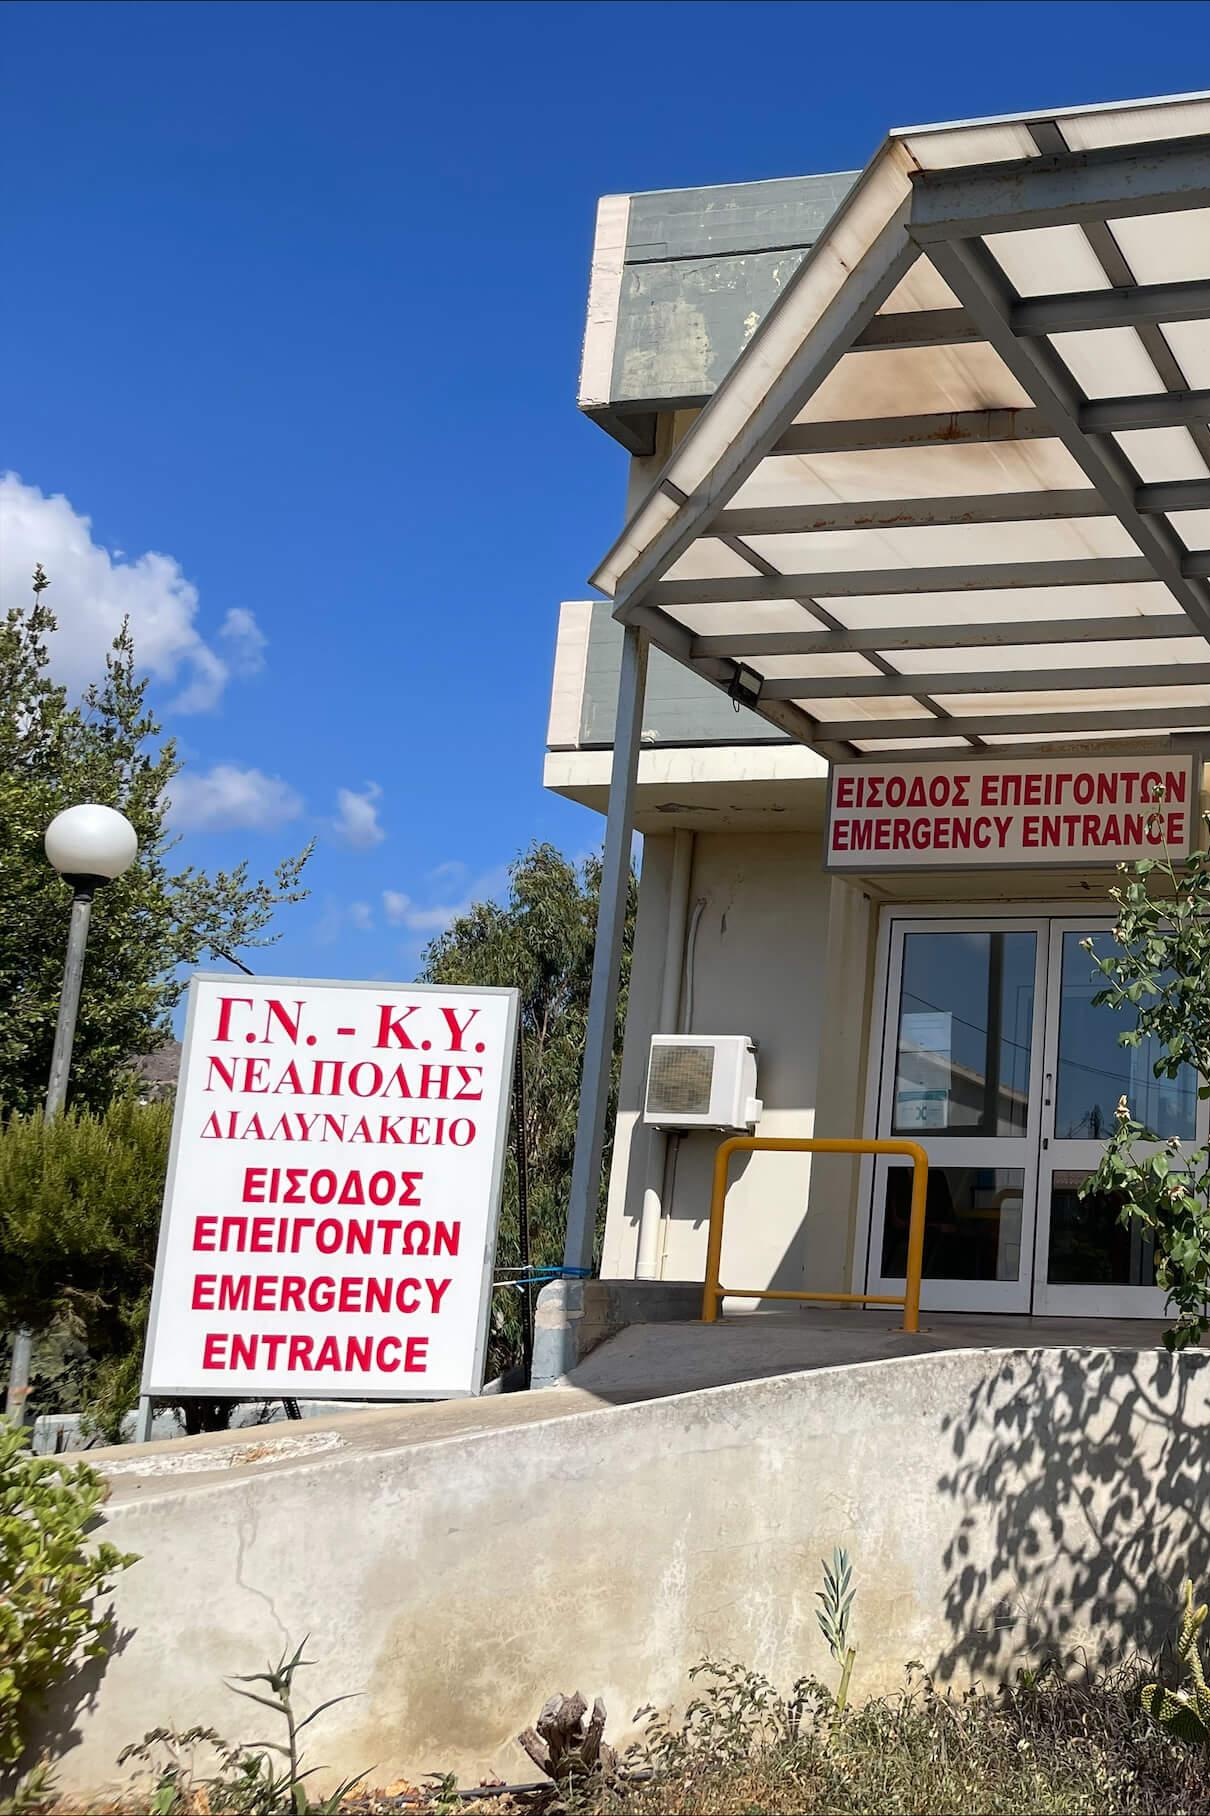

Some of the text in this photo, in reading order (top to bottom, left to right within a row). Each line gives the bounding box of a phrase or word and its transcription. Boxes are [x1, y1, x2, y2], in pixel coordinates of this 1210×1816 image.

[836, 771, 1186, 808] ΕΙΣΟΔΟΣ ΕΠΕΙΓΟΝΤΩΝ
[832, 812, 1186, 851] EMERGENCY ENTRANCE
[211, 996, 317, 1046] Γ.Ν.
[372, 1004, 486, 1053] Κ.Υ.
[203, 1056, 484, 1101] ΝΕΑΠΟΛΗΣ
[200, 1110, 477, 1147] ΔΙΑΛΥΝΑΚΕΙΟ
[242, 1167, 424, 1207] ΕΙΣΟΔΟΣ
[192, 1216, 461, 1257] ΕΠΕΙΓΟΝΤΩΝ
[191, 1274, 454, 1315] EMERGENCY
[202, 1333, 430, 1373] ENTRANCE
